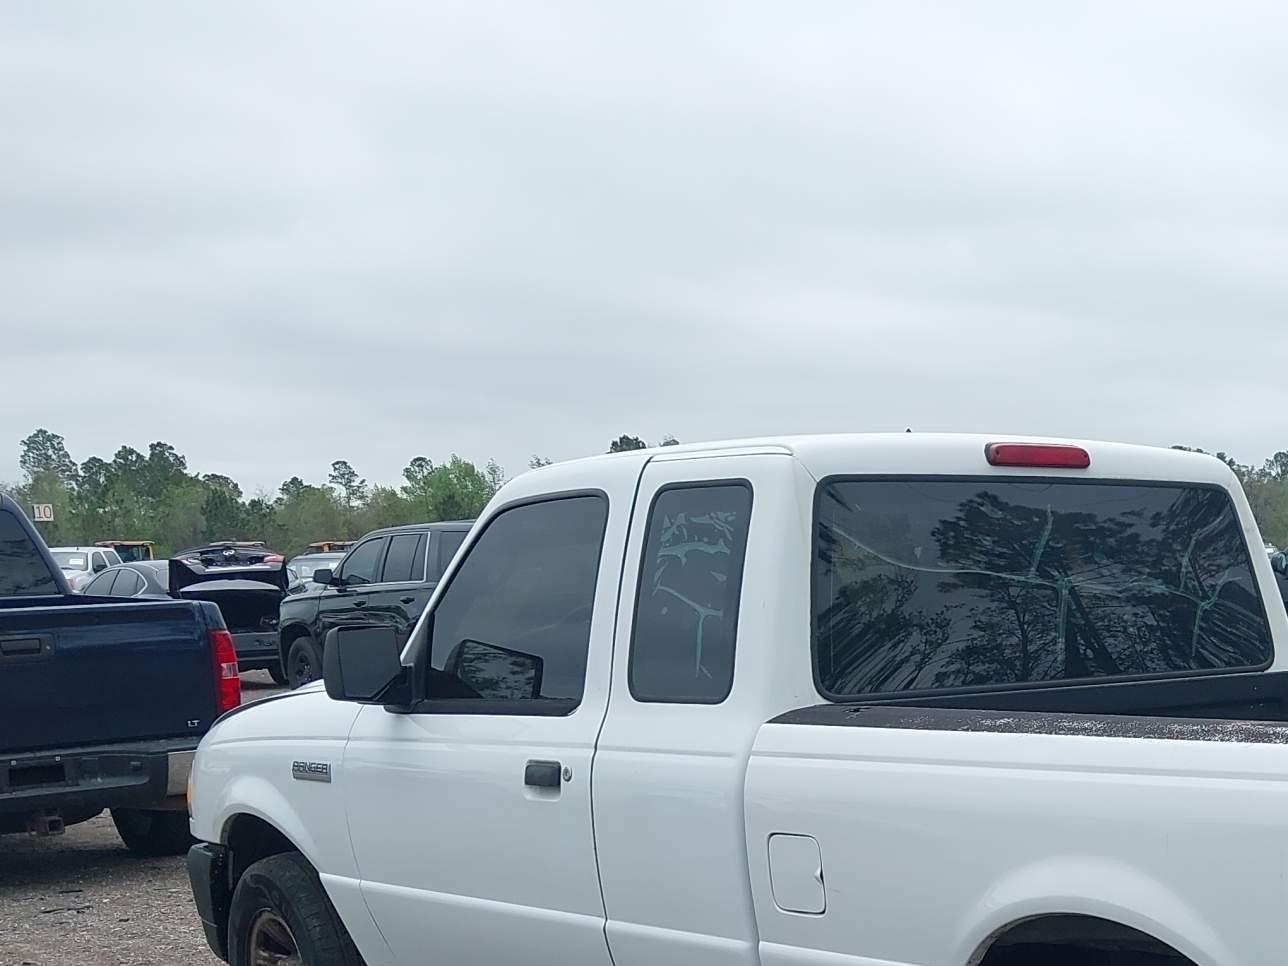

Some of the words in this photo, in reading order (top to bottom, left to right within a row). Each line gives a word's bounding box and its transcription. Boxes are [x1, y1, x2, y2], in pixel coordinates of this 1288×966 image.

[35, 505, 52, 519] 10
[187, 719, 200, 727] LT
[292, 760, 329, 775] RANGER
